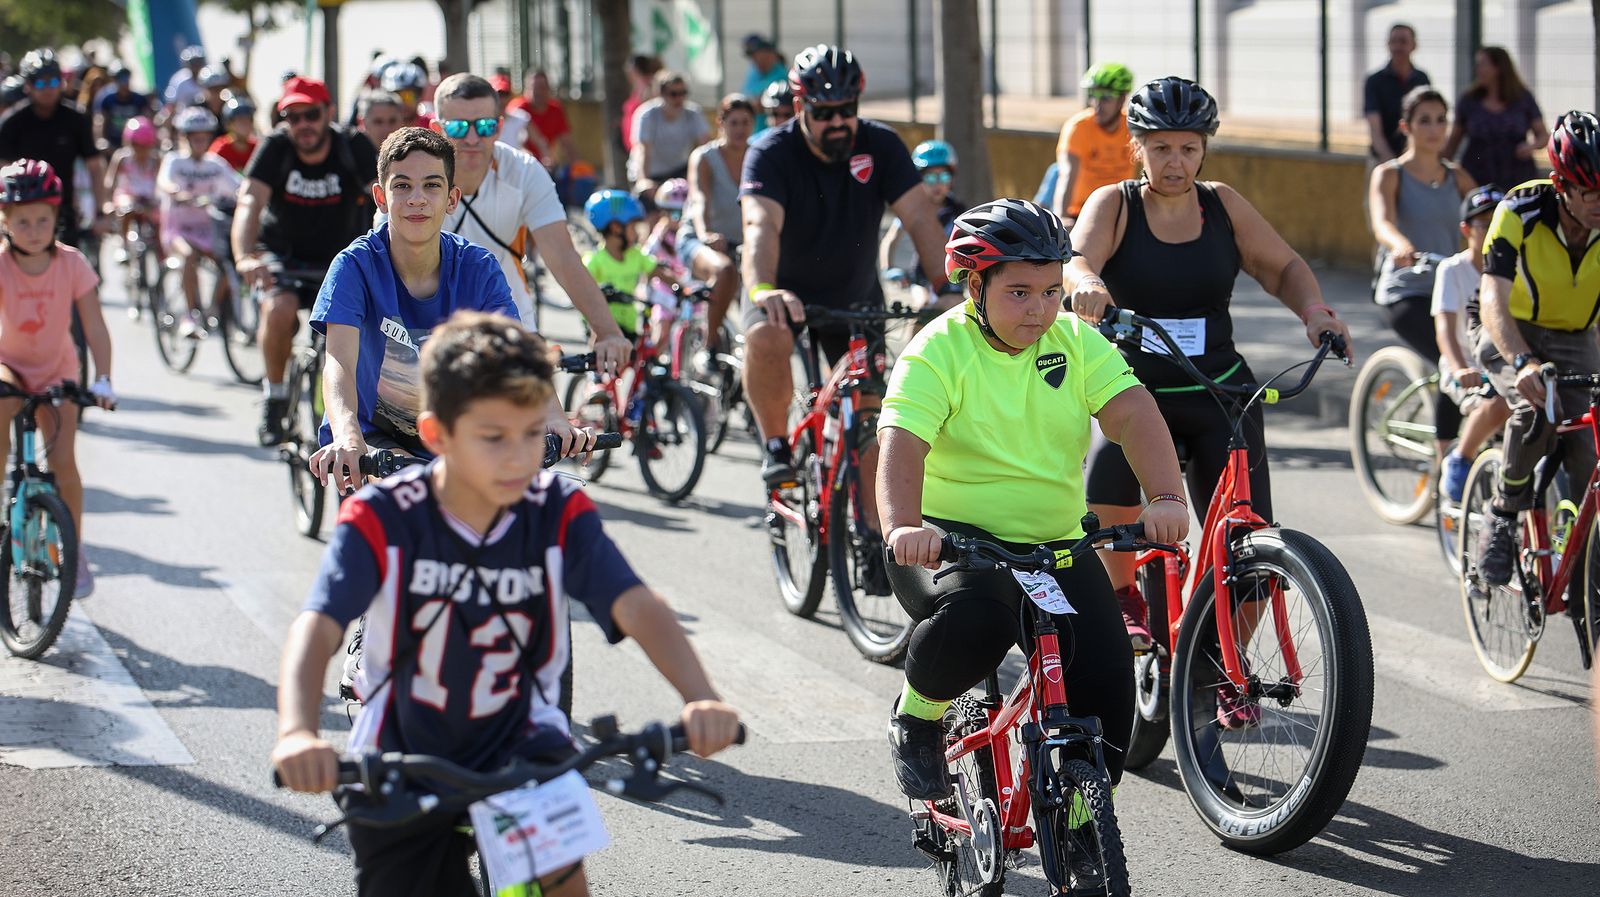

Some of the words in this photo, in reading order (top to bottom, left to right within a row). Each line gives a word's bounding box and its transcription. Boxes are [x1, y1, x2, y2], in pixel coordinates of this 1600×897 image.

[1037, 356, 1064, 366] DUCATI
[411, 599, 533, 720] 12
[1245, 801, 1290, 836] TIRE
